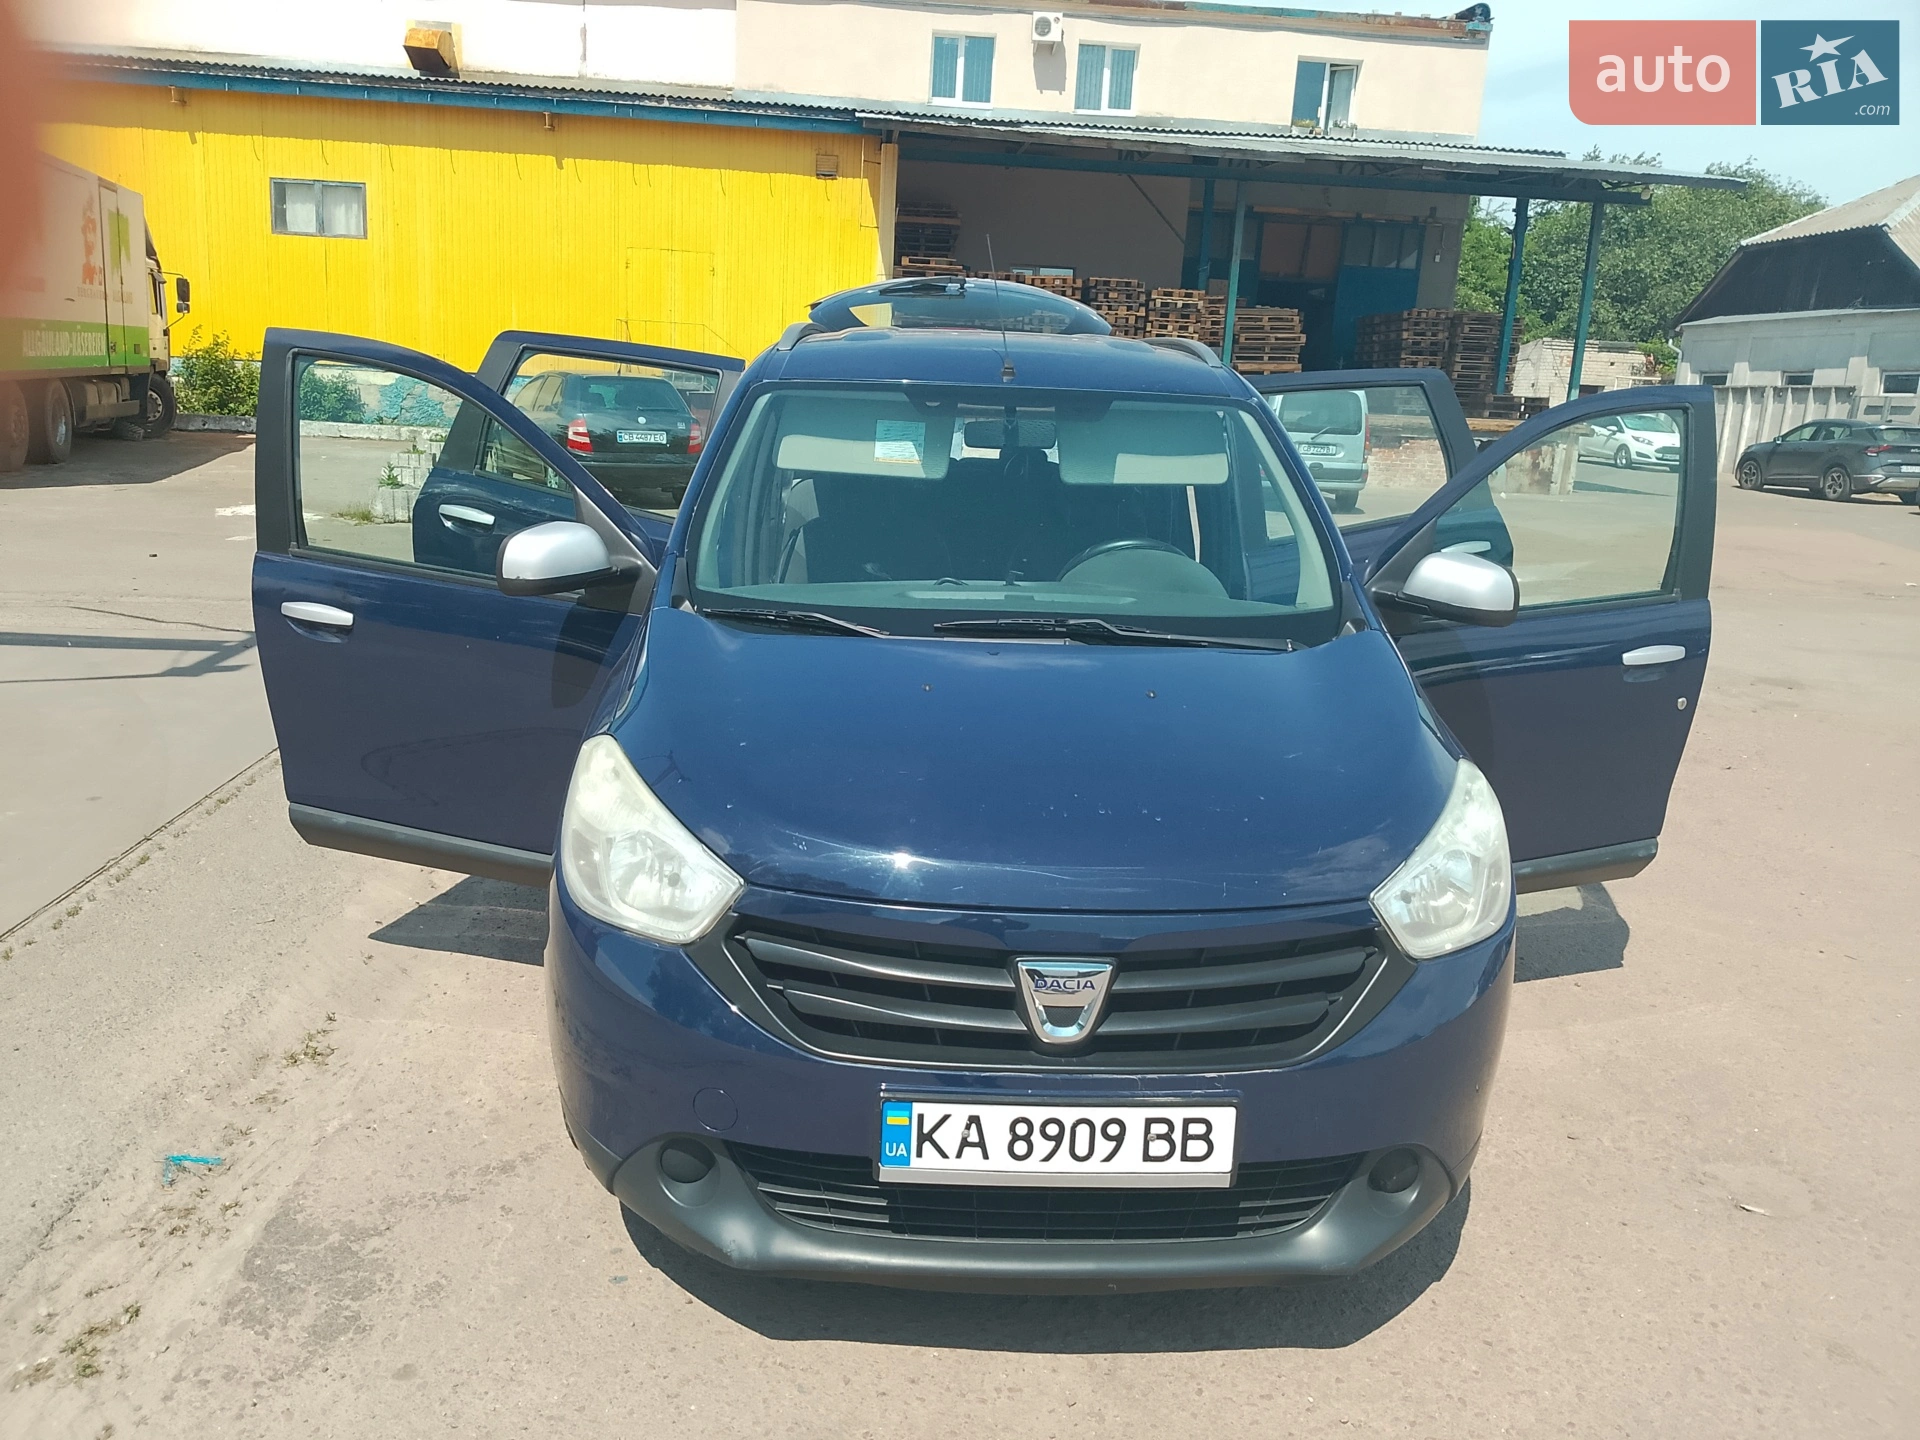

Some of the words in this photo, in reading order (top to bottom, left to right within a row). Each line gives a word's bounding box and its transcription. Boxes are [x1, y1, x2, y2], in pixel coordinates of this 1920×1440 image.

[623, 432, 634, 441] CB
[1034, 978, 1096, 991] DACIA
[915, 1113, 990, 1160] KA
[1007, 1116, 1127, 1163] 8909
[1141, 1117, 1215, 1163] BB
[885, 1142, 908, 1158] UA
